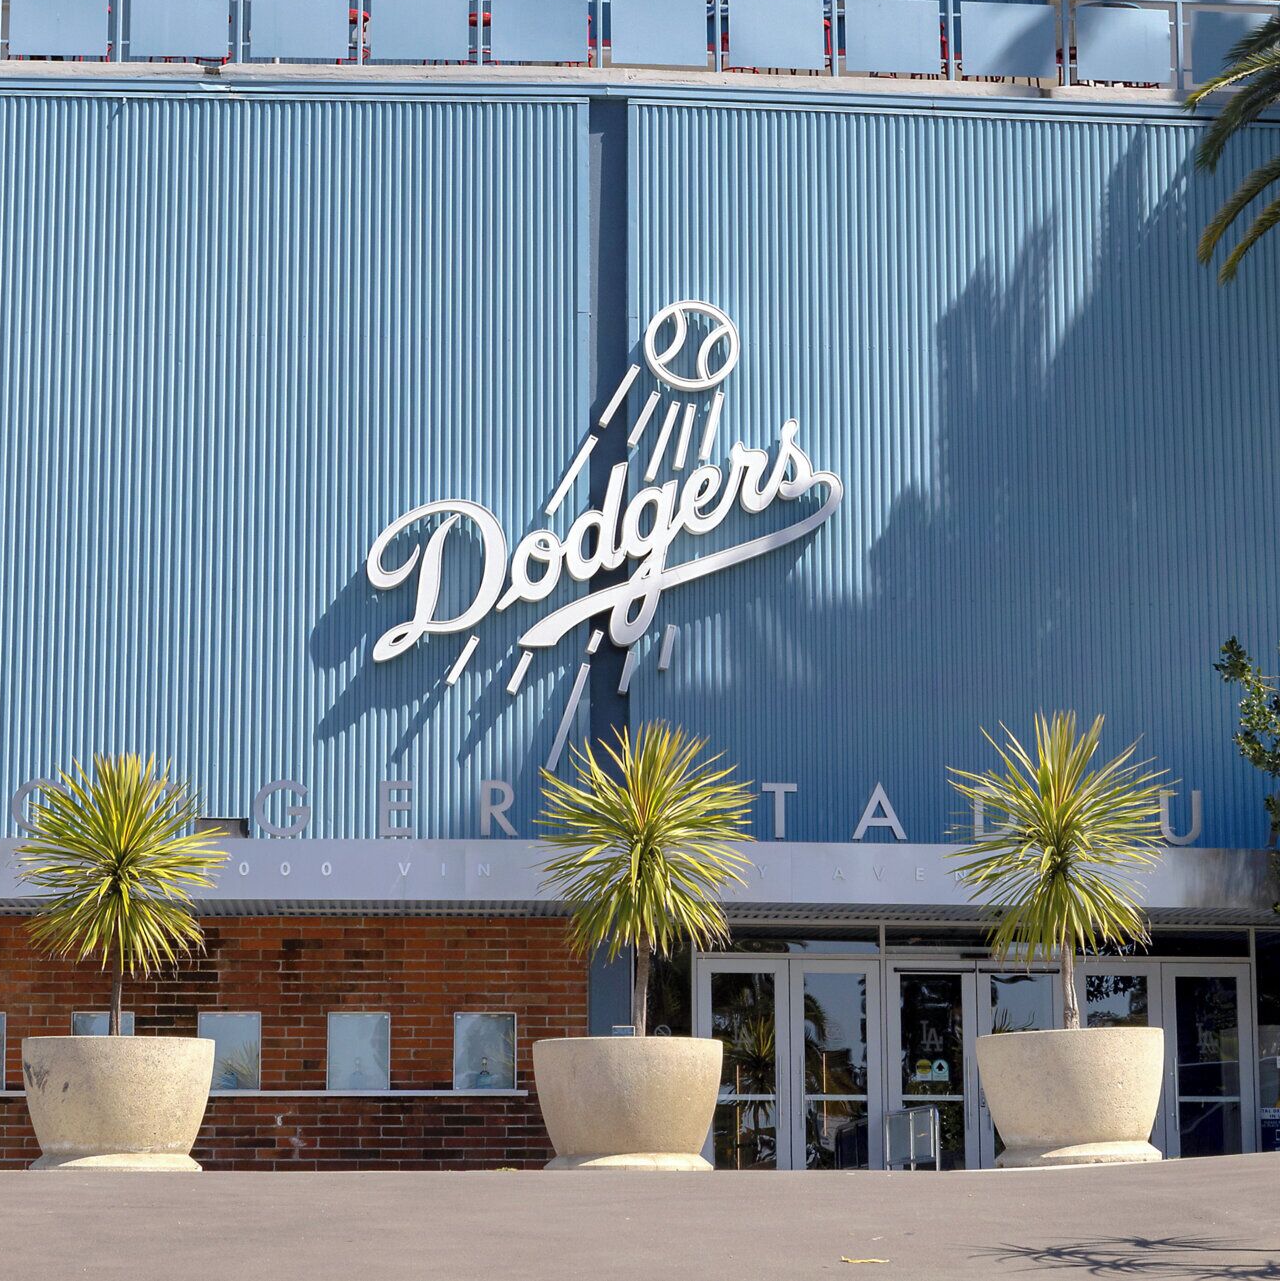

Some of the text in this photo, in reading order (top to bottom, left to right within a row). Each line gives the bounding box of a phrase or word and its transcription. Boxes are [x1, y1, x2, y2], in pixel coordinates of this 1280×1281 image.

[366, 418, 844, 664] Dodgers
[398, 862, 491, 878] VIN
[831, 865, 1009, 882] AVEN
[920, 1020, 944, 1052] LA
